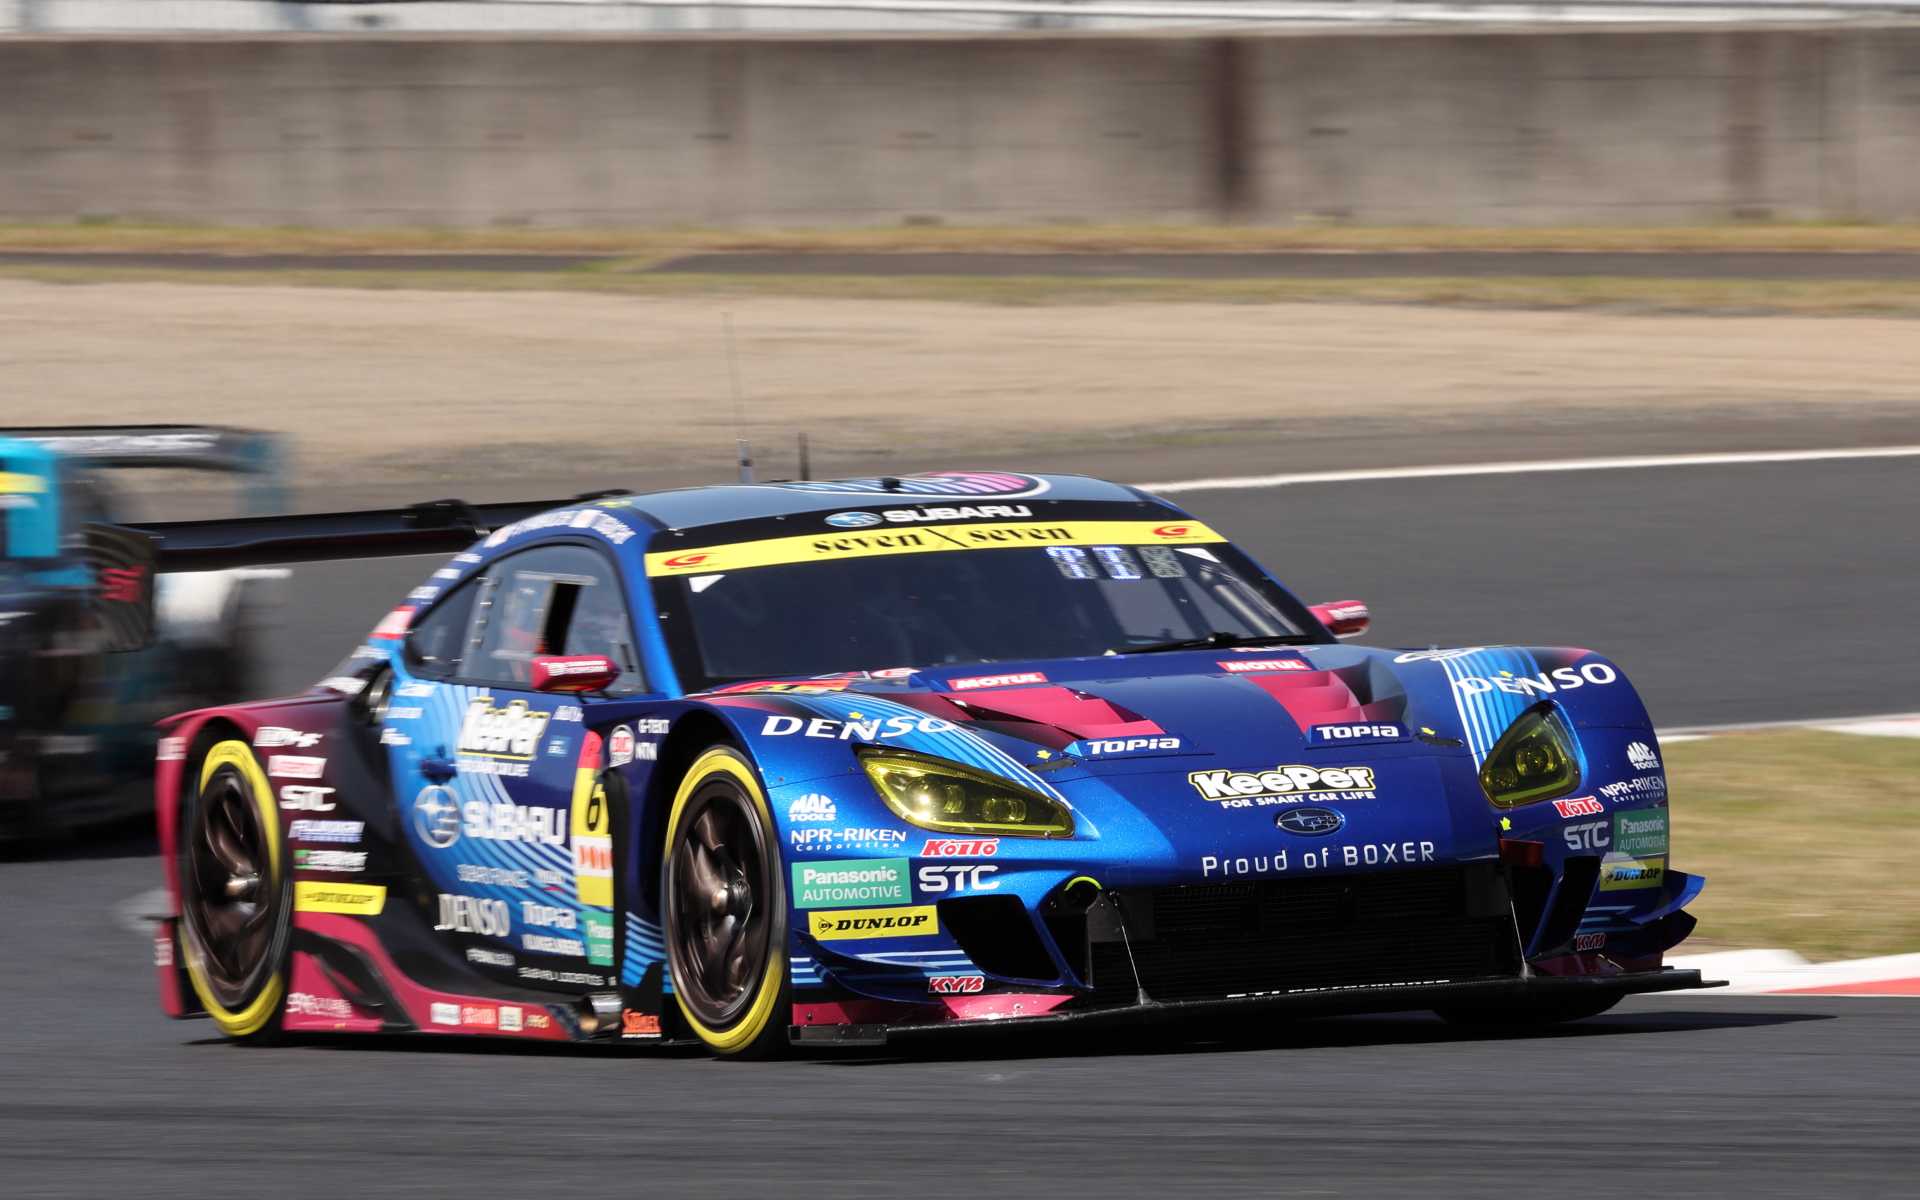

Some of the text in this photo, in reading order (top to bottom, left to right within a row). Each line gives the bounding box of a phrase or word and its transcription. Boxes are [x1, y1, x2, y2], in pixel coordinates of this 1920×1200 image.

[882, 506, 1033, 523] SUBARU
[813, 533, 924, 553] seven
[968, 528, 1074, 542] seven
[1226, 660, 1306, 671] MOTUL
[956, 674, 1043, 689] MOTUL
[1455, 663, 1617, 696] DENSO
[761, 715, 959, 741] DENSO
[1626, 741, 1657, 764] MAC
[1633, 761, 1660, 771] TOOLS
[1194, 767, 1372, 798] KeePer
[1598, 776, 1665, 798] NPR-RIKEN
[788, 793, 837, 814] MAC
[1220, 791, 1376, 809] FOR SMART CAR LIFE
[789, 812, 836, 822] TOOLS
[1621, 815, 1665, 835] Panasonic
[790, 827, 907, 845] NPR-RIKEN
[1563, 821, 1610, 850] STC
[1619, 835, 1666, 851] AUTOMOTIVE
[796, 841, 900, 852] Corporation
[1202, 841, 1436, 877] Proud of BOXER
[803, 866, 898, 885] Panasonic
[919, 865, 1000, 892] STC
[1613, 867, 1661, 882] DUNLOP
[802, 885, 902, 901] AUTOMOTIVE
[438, 893, 511, 937] DENSO
[835, 915, 929, 931] DUNLOP
[1576, 933, 1606, 951] KYB
[928, 976, 985, 993] KYB
